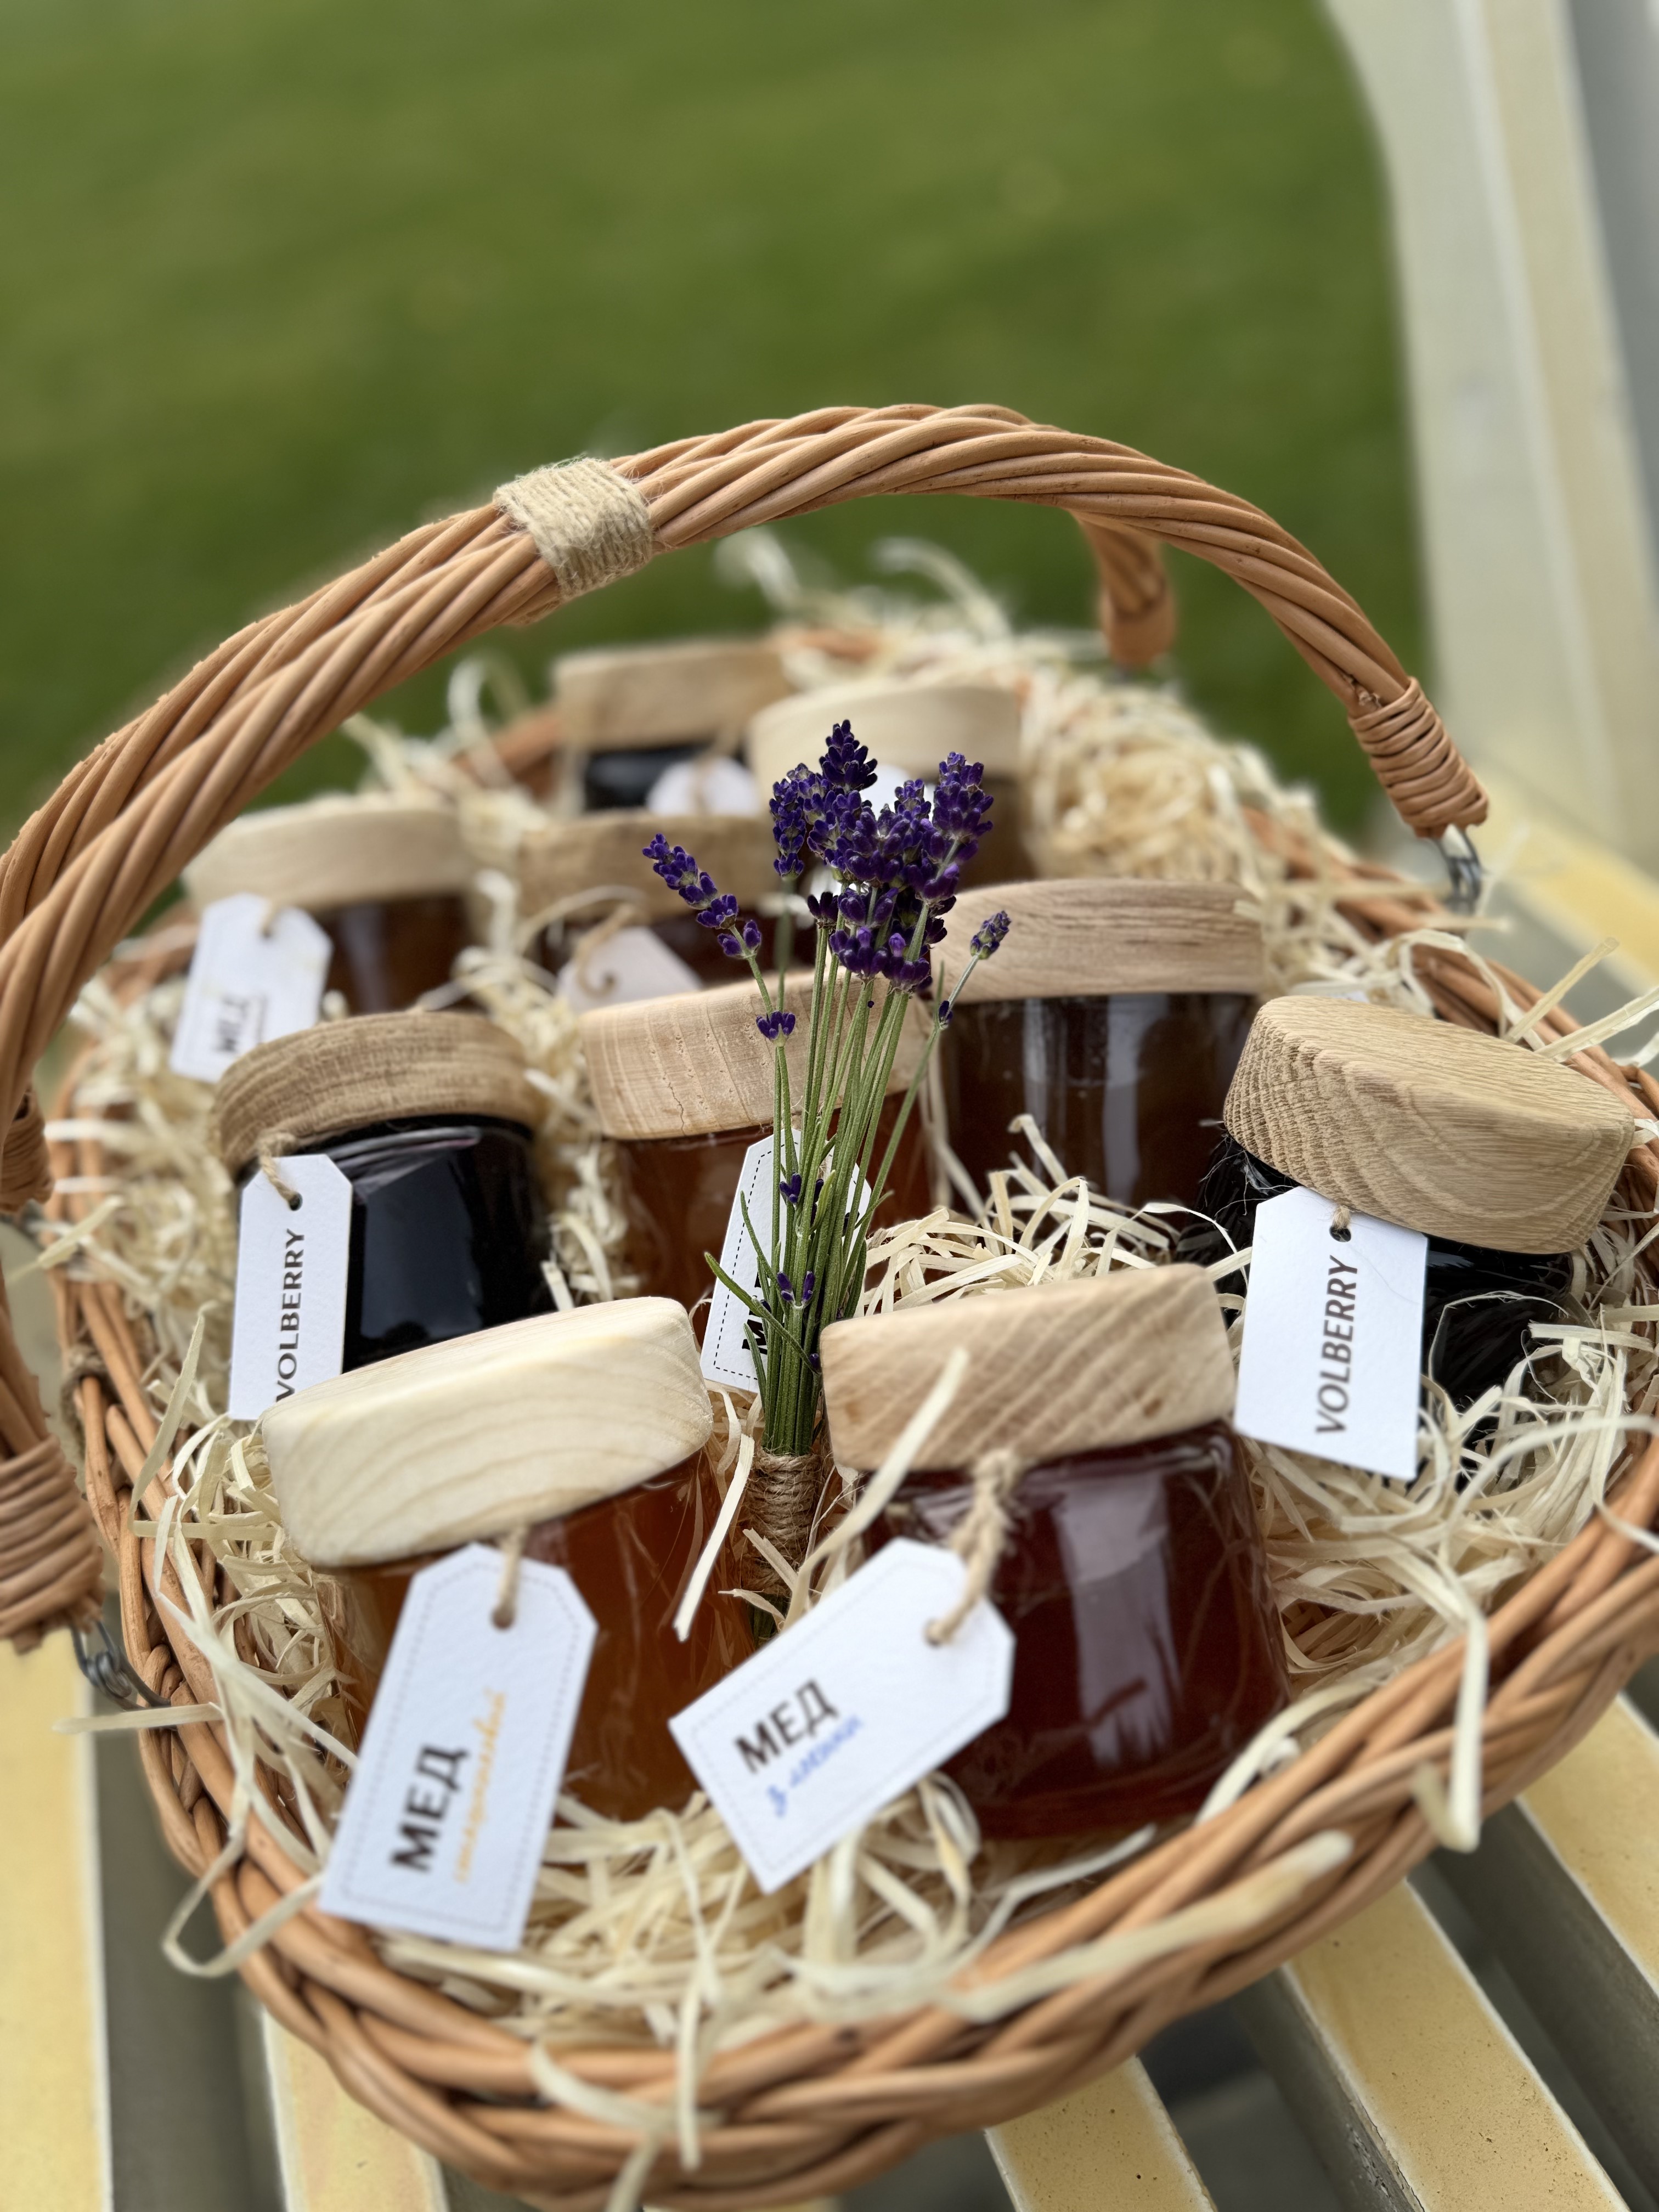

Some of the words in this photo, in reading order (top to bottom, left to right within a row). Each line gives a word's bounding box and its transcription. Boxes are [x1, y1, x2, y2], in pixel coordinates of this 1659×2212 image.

[276, 1228, 304, 1402] VOLBERRY
[1315, 1254, 1358, 1434] VOLBERRY
[734, 1678, 839, 1775] МЕД
[390, 1743, 470, 1874] МЕД
